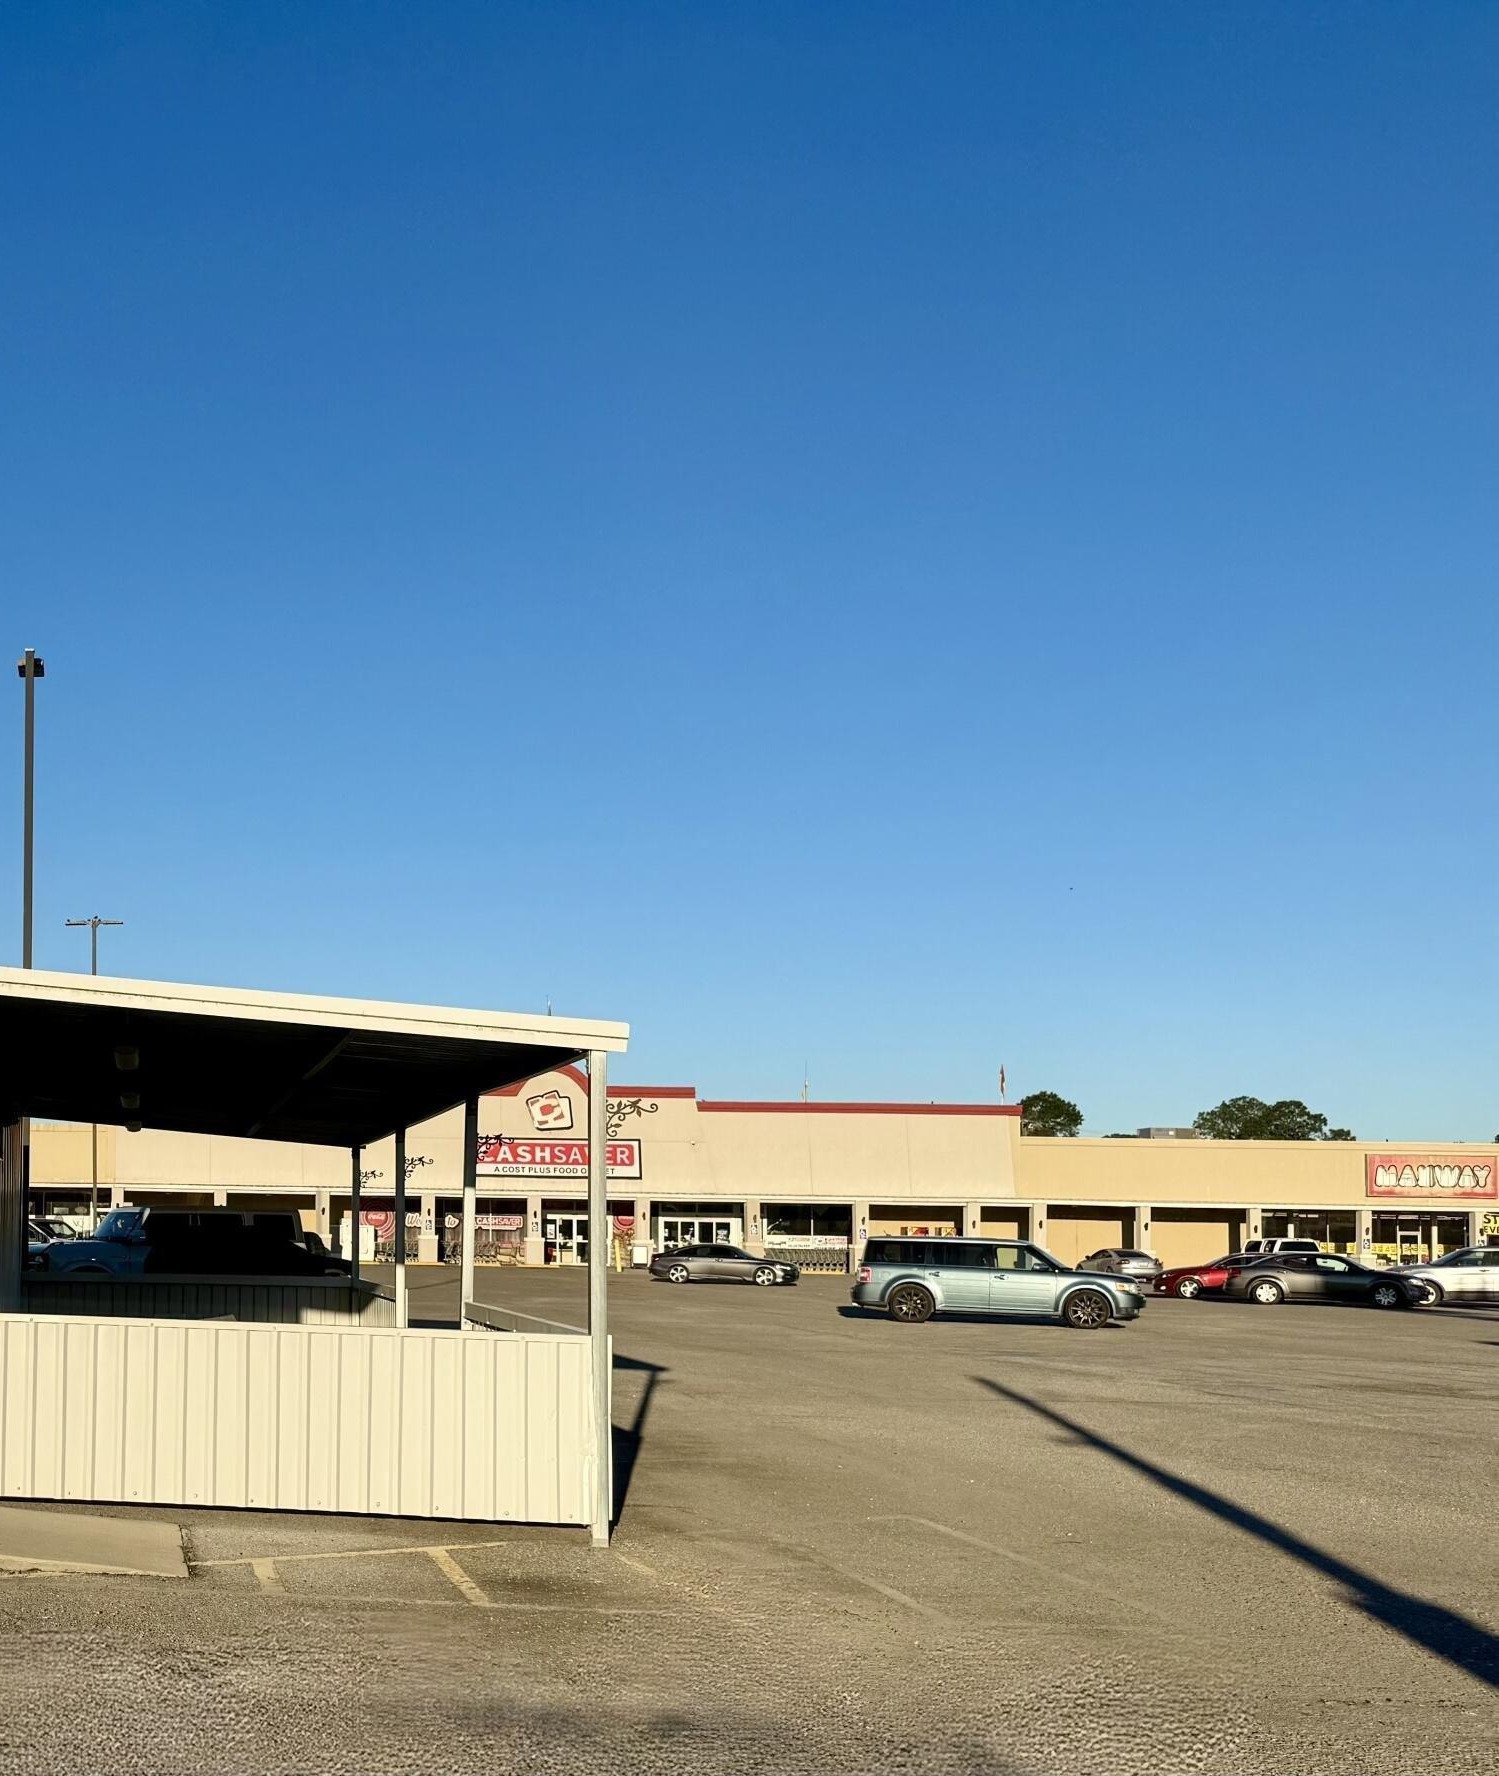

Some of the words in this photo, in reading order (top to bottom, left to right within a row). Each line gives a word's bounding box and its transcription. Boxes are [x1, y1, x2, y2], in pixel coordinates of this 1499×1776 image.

[478, 1144, 630, 1164] CASHSAER
[501, 1166, 526, 1174] COST
[528, 1166, 551, 1174] PLUS
